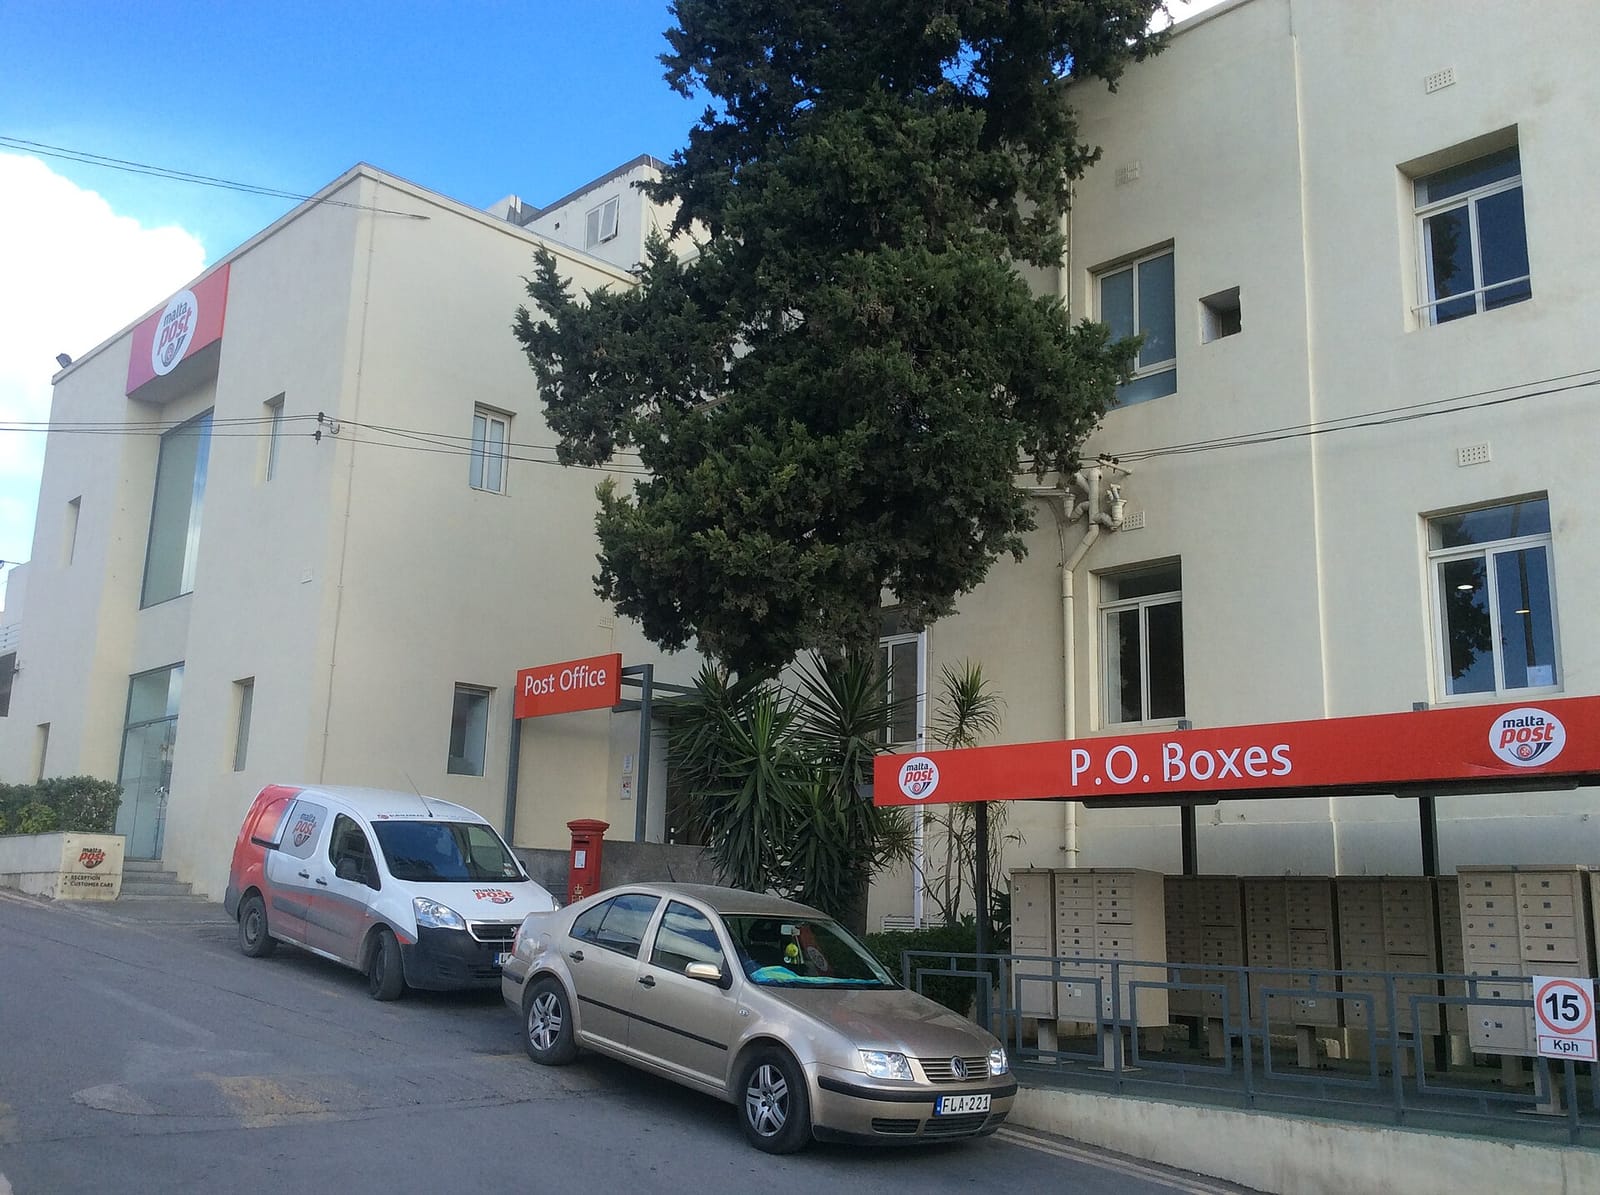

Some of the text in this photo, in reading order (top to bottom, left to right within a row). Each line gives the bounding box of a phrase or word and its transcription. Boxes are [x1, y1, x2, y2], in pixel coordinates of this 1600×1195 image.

[163, 302, 188, 327] malta
[157, 306, 192, 356] post
[524, 665, 606, 697] Post Office
[1503, 716, 1545, 728] malta
[1499, 722, 1555, 749] post
[906, 762, 929, 771] malta
[1070, 742, 1293, 787] P.O. Boxes
[904, 767, 934, 786] post
[292, 820, 317, 836] post
[78, 851, 106, 863] post
[475, 890, 513, 900] post
[1545, 993, 1580, 1022] 15
[1553, 1039, 1579, 1053] Kph
